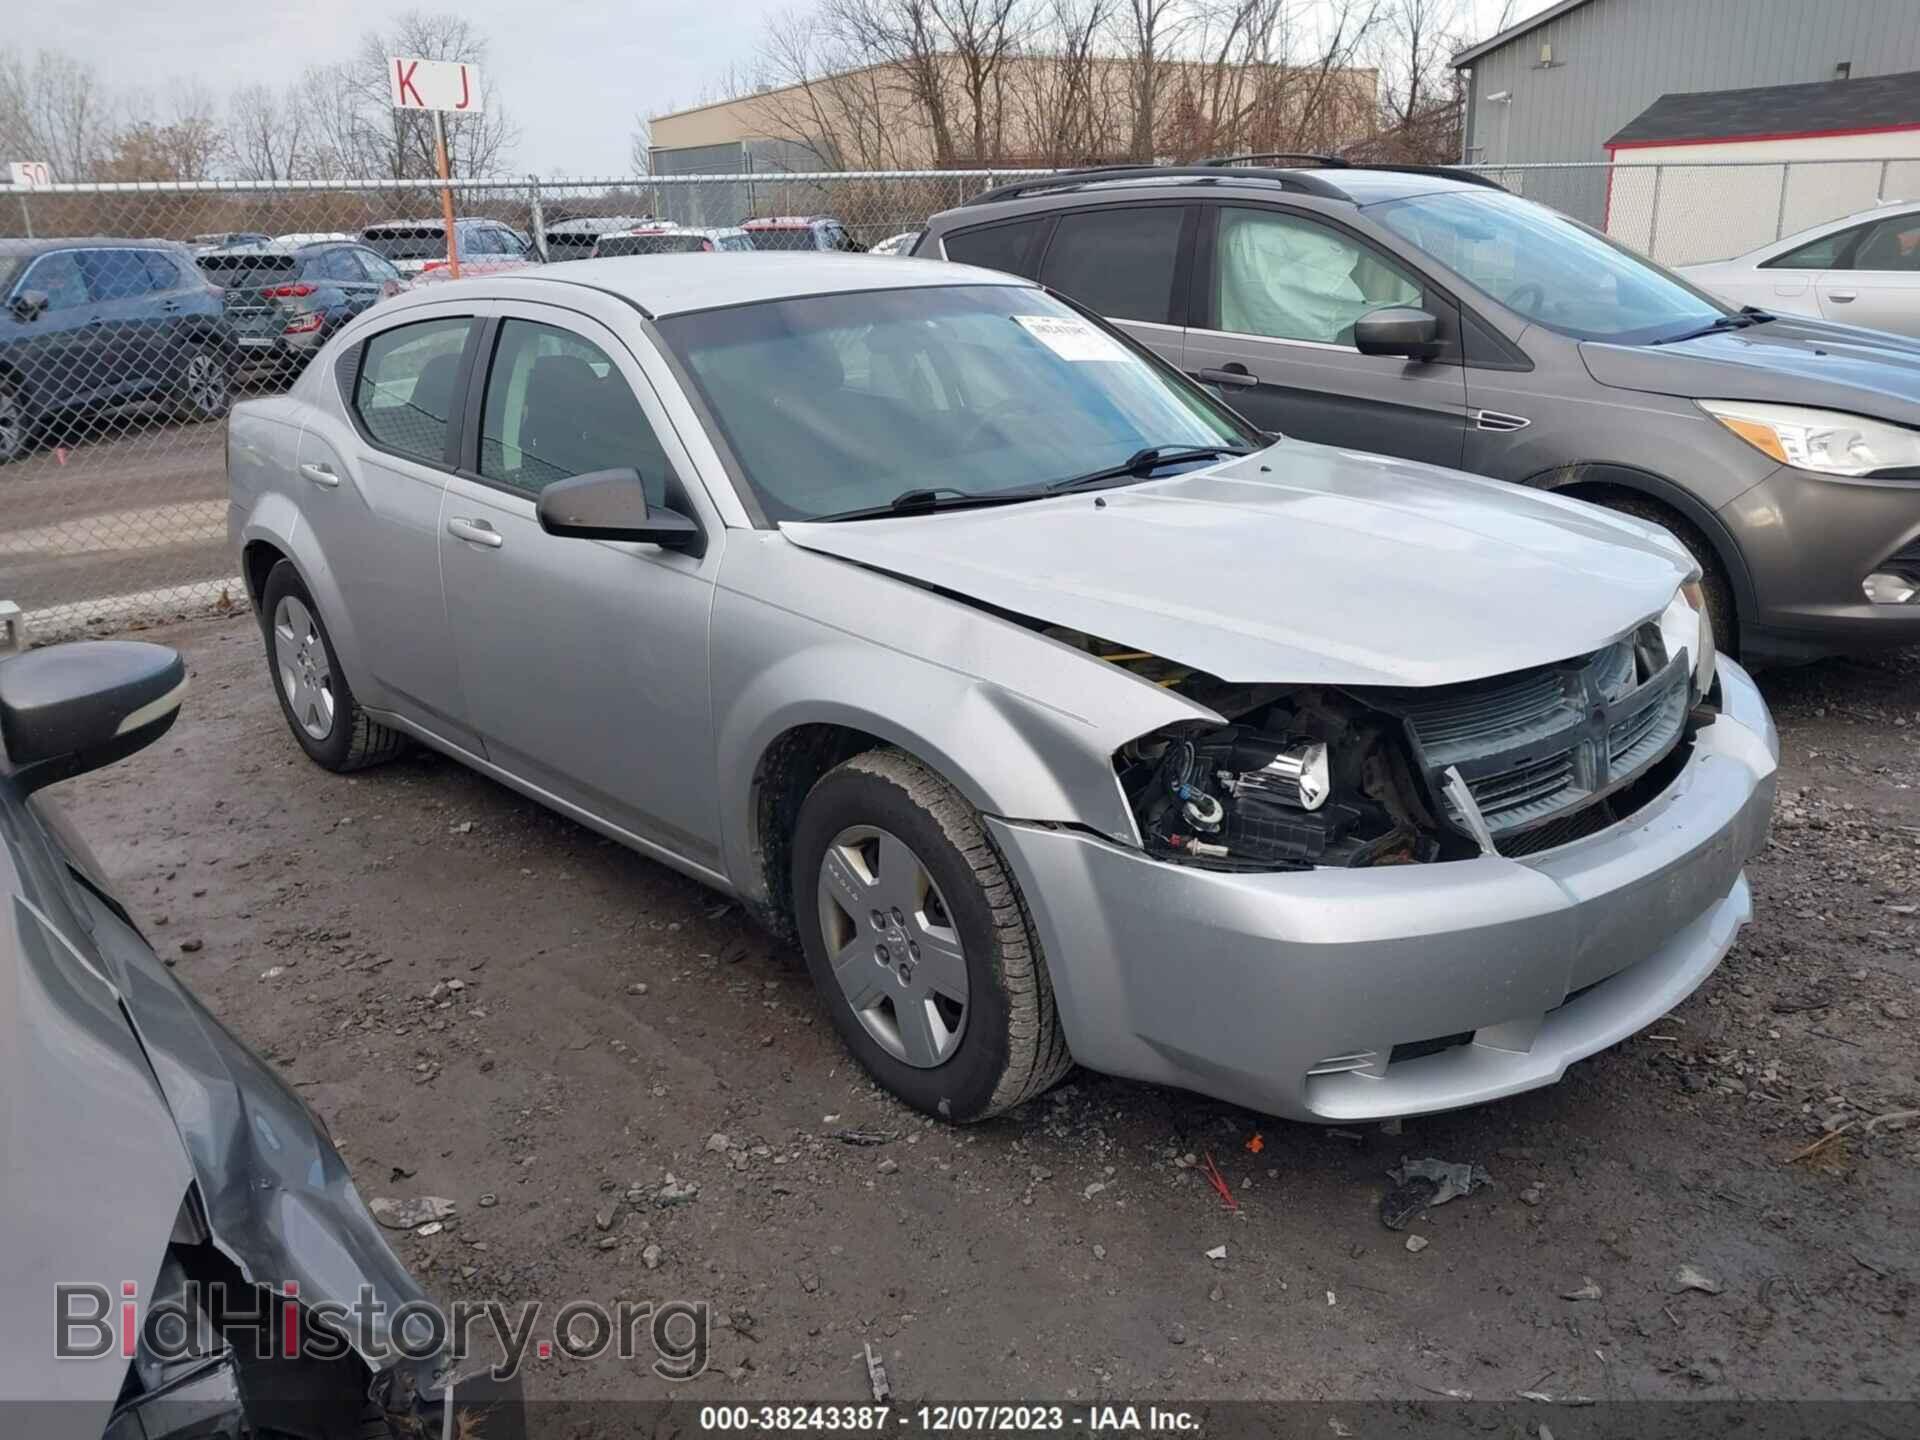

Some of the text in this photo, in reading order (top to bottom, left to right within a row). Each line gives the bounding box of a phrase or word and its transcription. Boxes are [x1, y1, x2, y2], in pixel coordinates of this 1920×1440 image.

[396, 59, 469, 109] K J
[22, 163, 48, 185] 50
